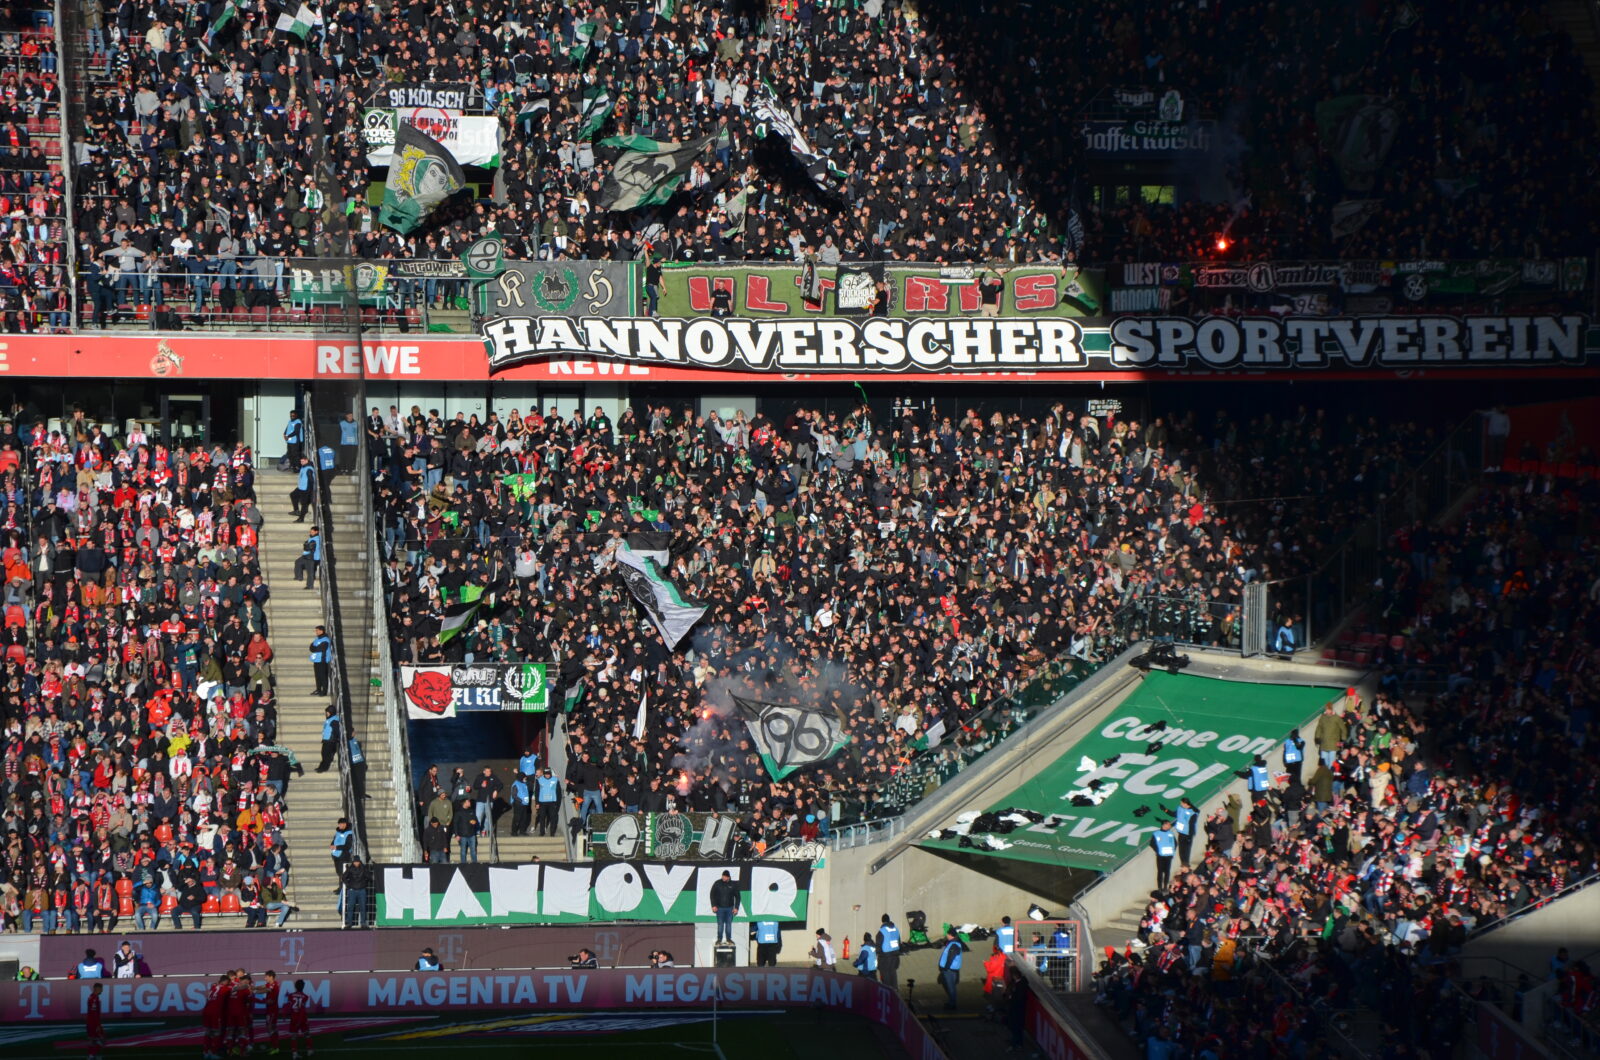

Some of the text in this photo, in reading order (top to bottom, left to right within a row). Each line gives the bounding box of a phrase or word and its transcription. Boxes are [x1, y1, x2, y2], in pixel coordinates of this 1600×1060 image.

[389, 84, 465, 109] 96 KÖLSCH
[1124, 263, 1161, 286] WEST
[317, 346, 420, 372] REWE
[487, 318, 1580, 367] HANNOVERSCHER SPORTVEREIN
[765, 708, 827, 768] 96
[1101, 716, 1218, 749] Come
[1073, 753, 1230, 800] FC!
[606, 814, 640, 858] G
[384, 864, 797, 921] HANNOVER
[80, 979, 332, 1016] MEGASEAM
[367, 974, 589, 1007] MAGENTA TV
[625, 972, 853, 1009] MEGASTREAM
